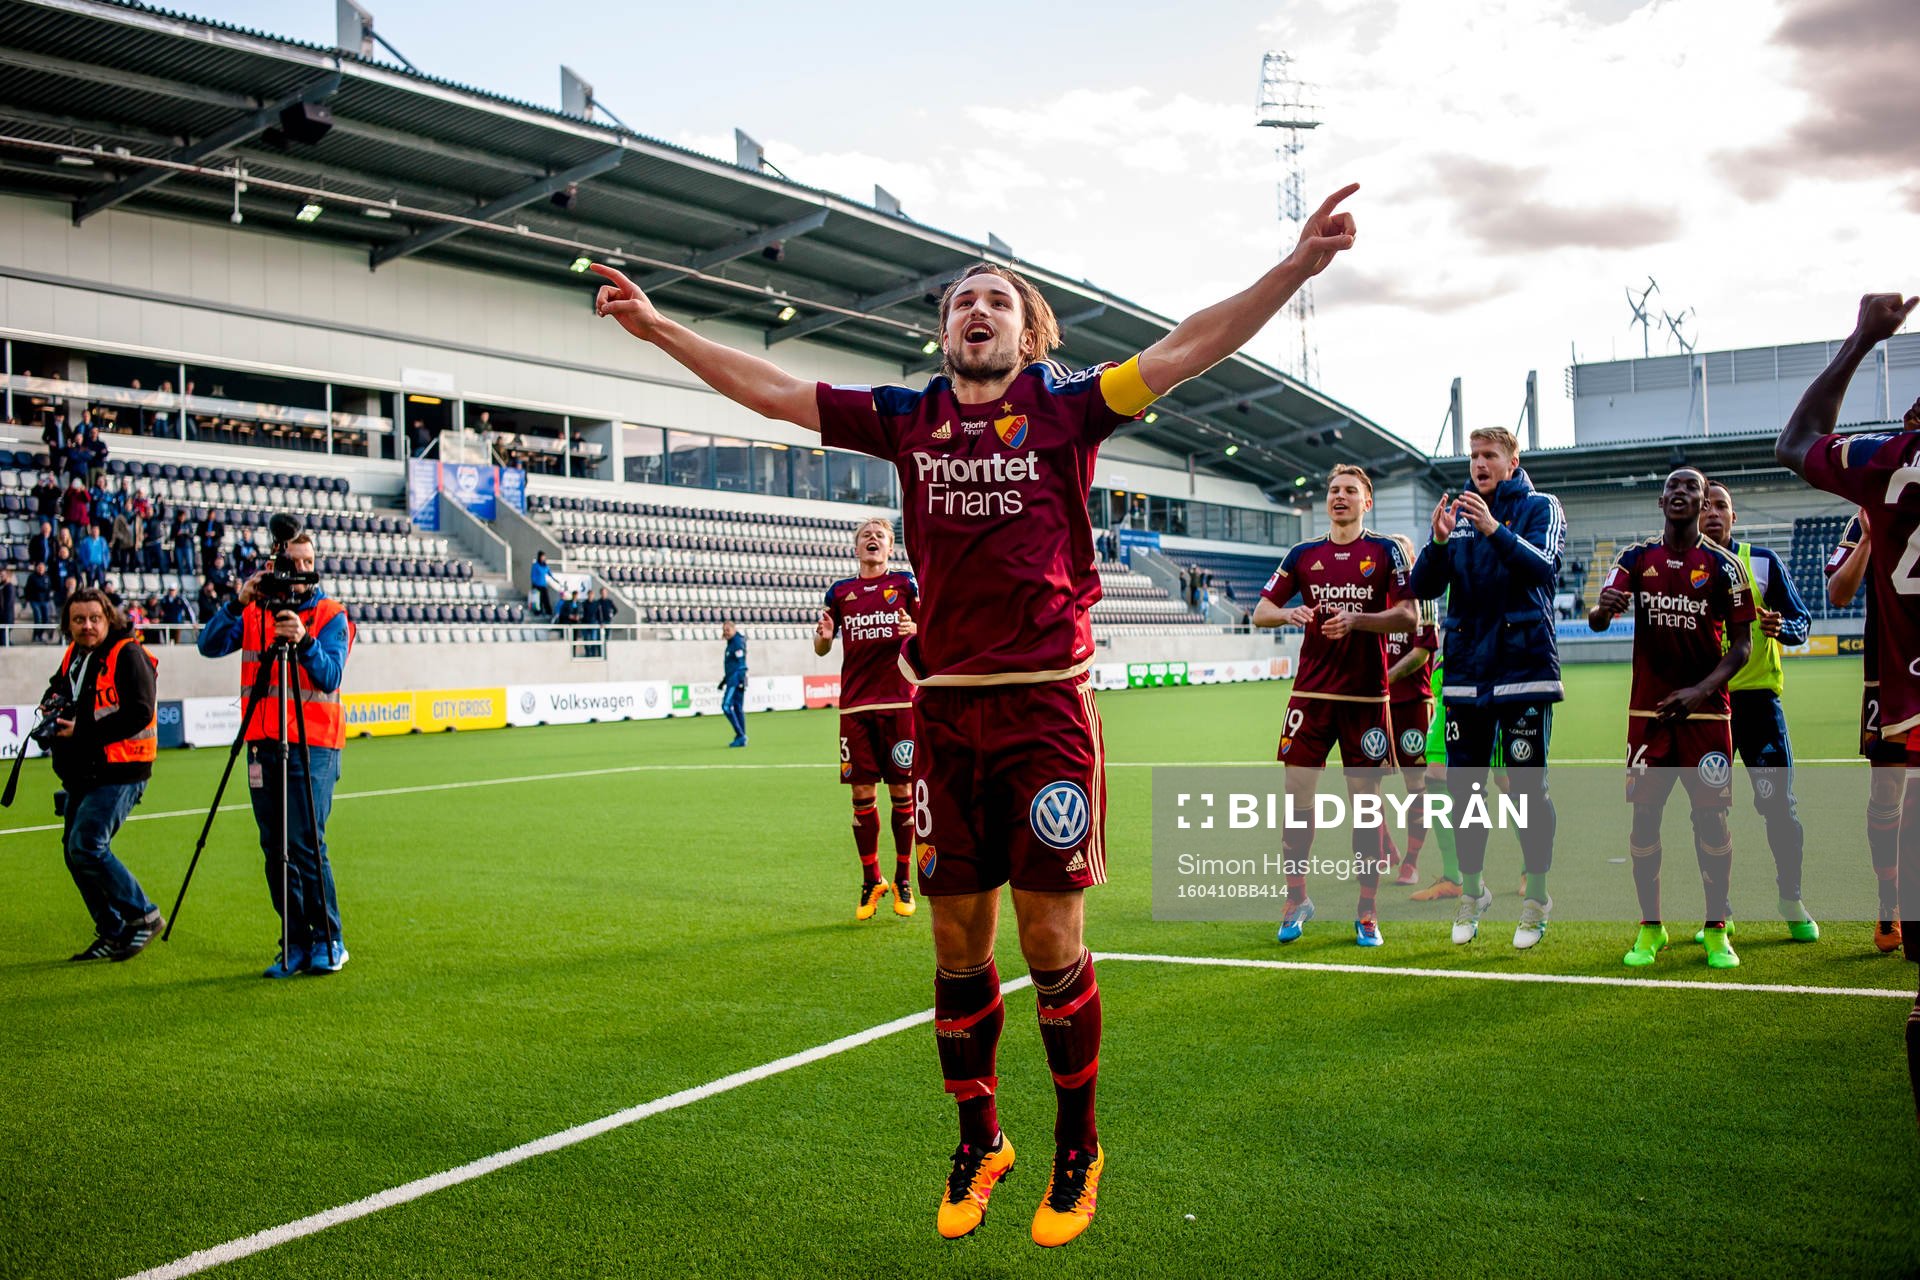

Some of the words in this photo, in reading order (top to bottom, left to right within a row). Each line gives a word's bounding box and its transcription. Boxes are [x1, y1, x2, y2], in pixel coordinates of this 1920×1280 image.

[913, 451, 1039, 482] Prioritet
[928, 483, 1023, 516] Finans
[1310, 583, 1374, 600] Prioritet
[1640, 591, 1708, 616] Prioritet
[844, 611, 900, 629] Prioritet
[1648, 608, 1697, 630] Finans
[851, 626, 893, 641] Finans
[433, 701, 455, 718] CITY
[458, 699, 492, 716] GROSS
[550, 692, 634, 711] Volkswagen
[1281, 708, 1304, 737] 19
[1446, 721, 1460, 741] 23
[914, 778, 933, 838] 8
[1066, 861, 1087, 872] adidas
